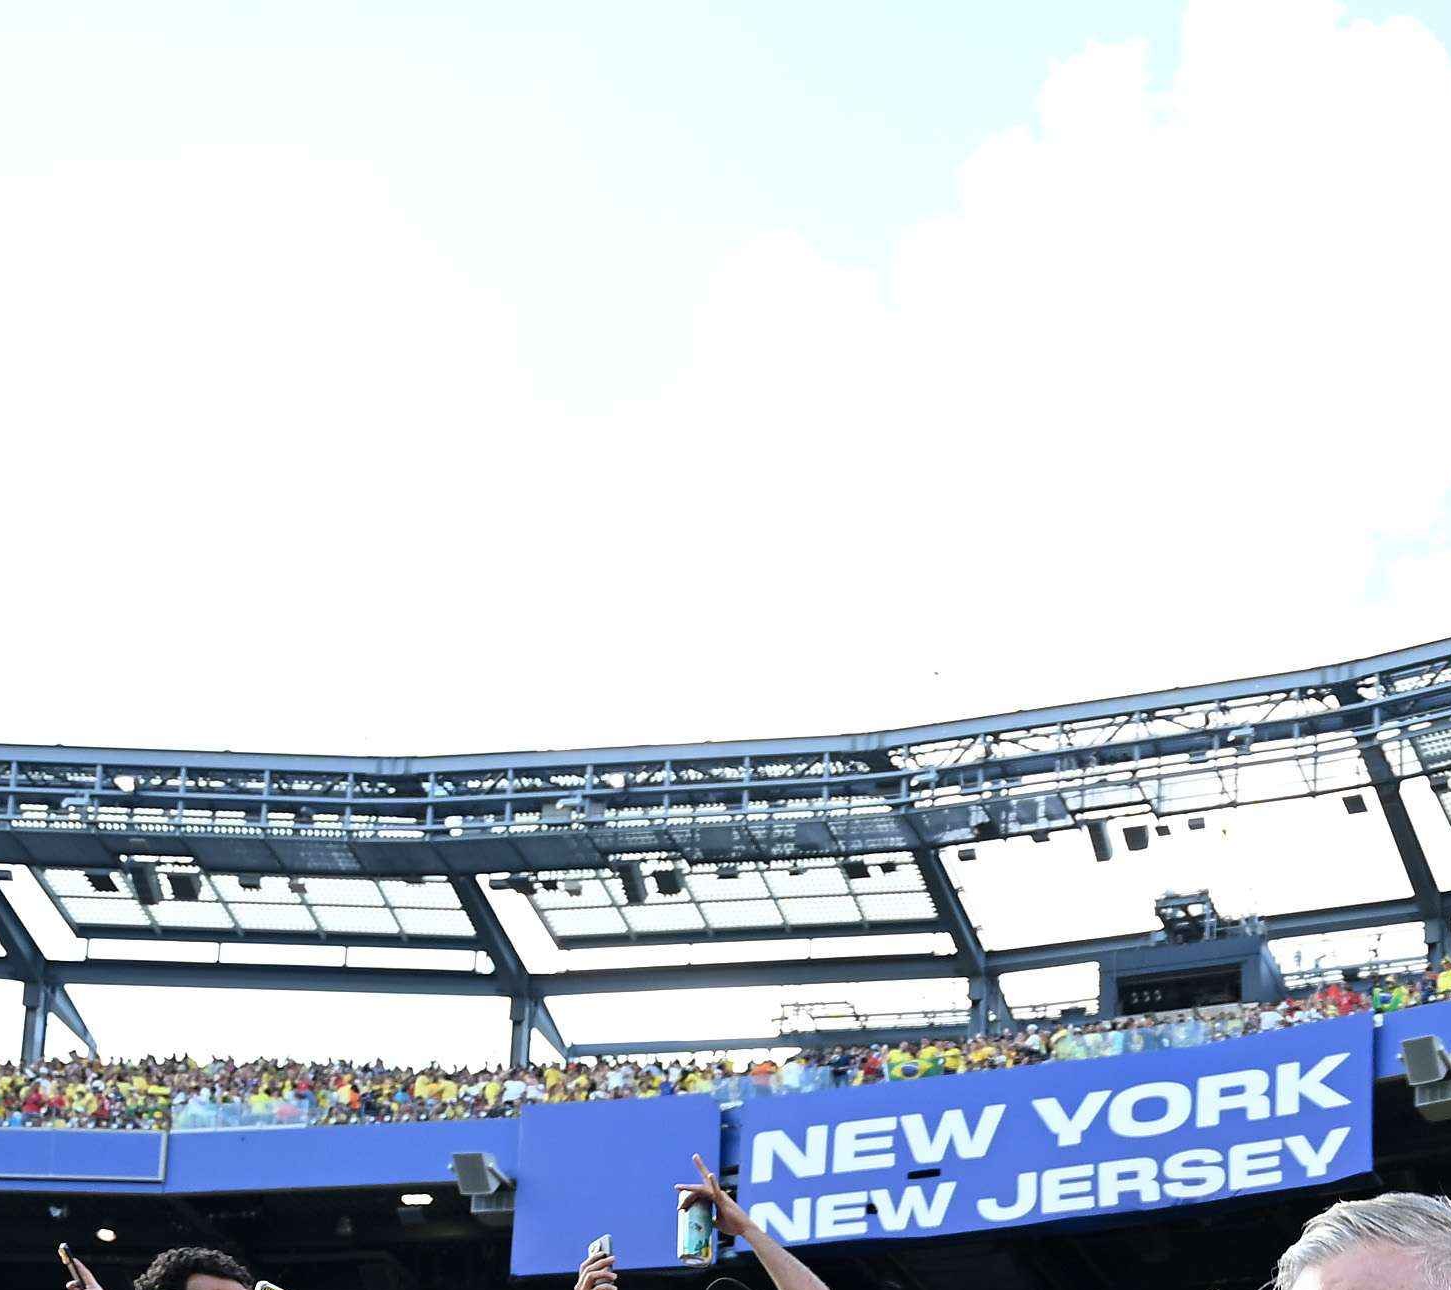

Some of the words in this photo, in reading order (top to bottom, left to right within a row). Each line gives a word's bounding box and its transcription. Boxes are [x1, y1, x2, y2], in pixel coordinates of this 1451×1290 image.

[750, 1104, 1006, 1184] NEW
[1031, 1052, 1352, 1147] YORK
[749, 1181, 957, 1243] NEW
[976, 1127, 1352, 1222] JERSEY
